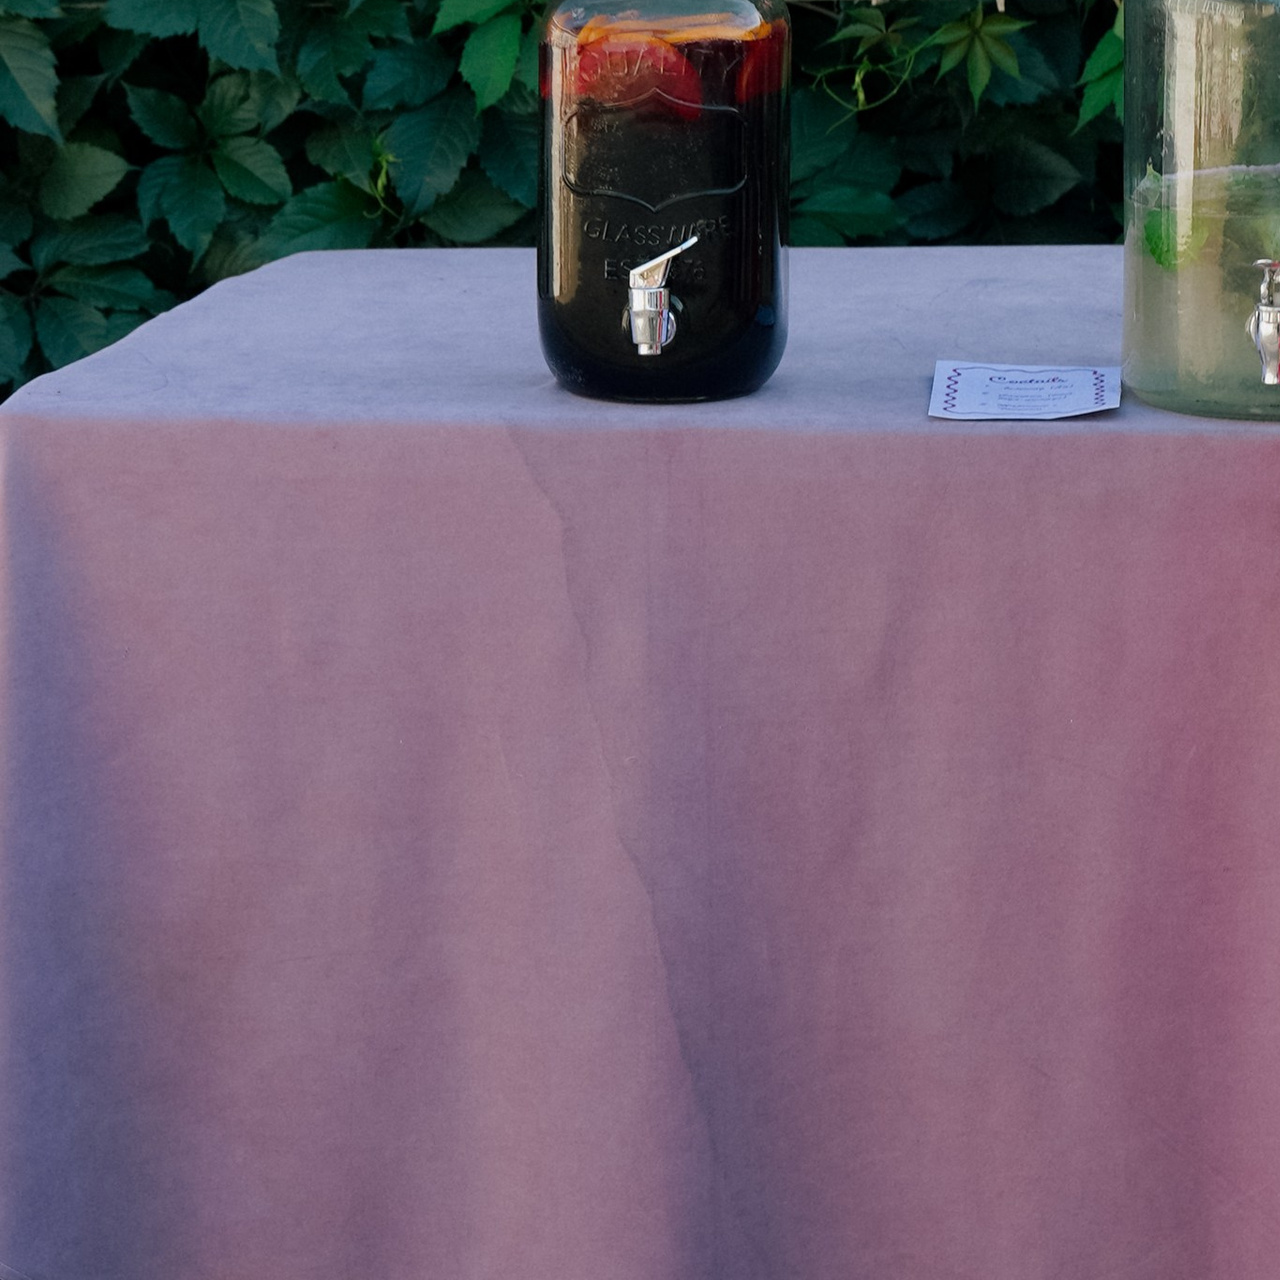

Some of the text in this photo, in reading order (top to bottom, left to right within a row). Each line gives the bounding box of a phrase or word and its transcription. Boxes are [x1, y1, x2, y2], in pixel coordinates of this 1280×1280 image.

[577, 43, 745, 85] QUALITY
[584, 215, 728, 247] GLASSWARE
[603, 258, 633, 281] ES
